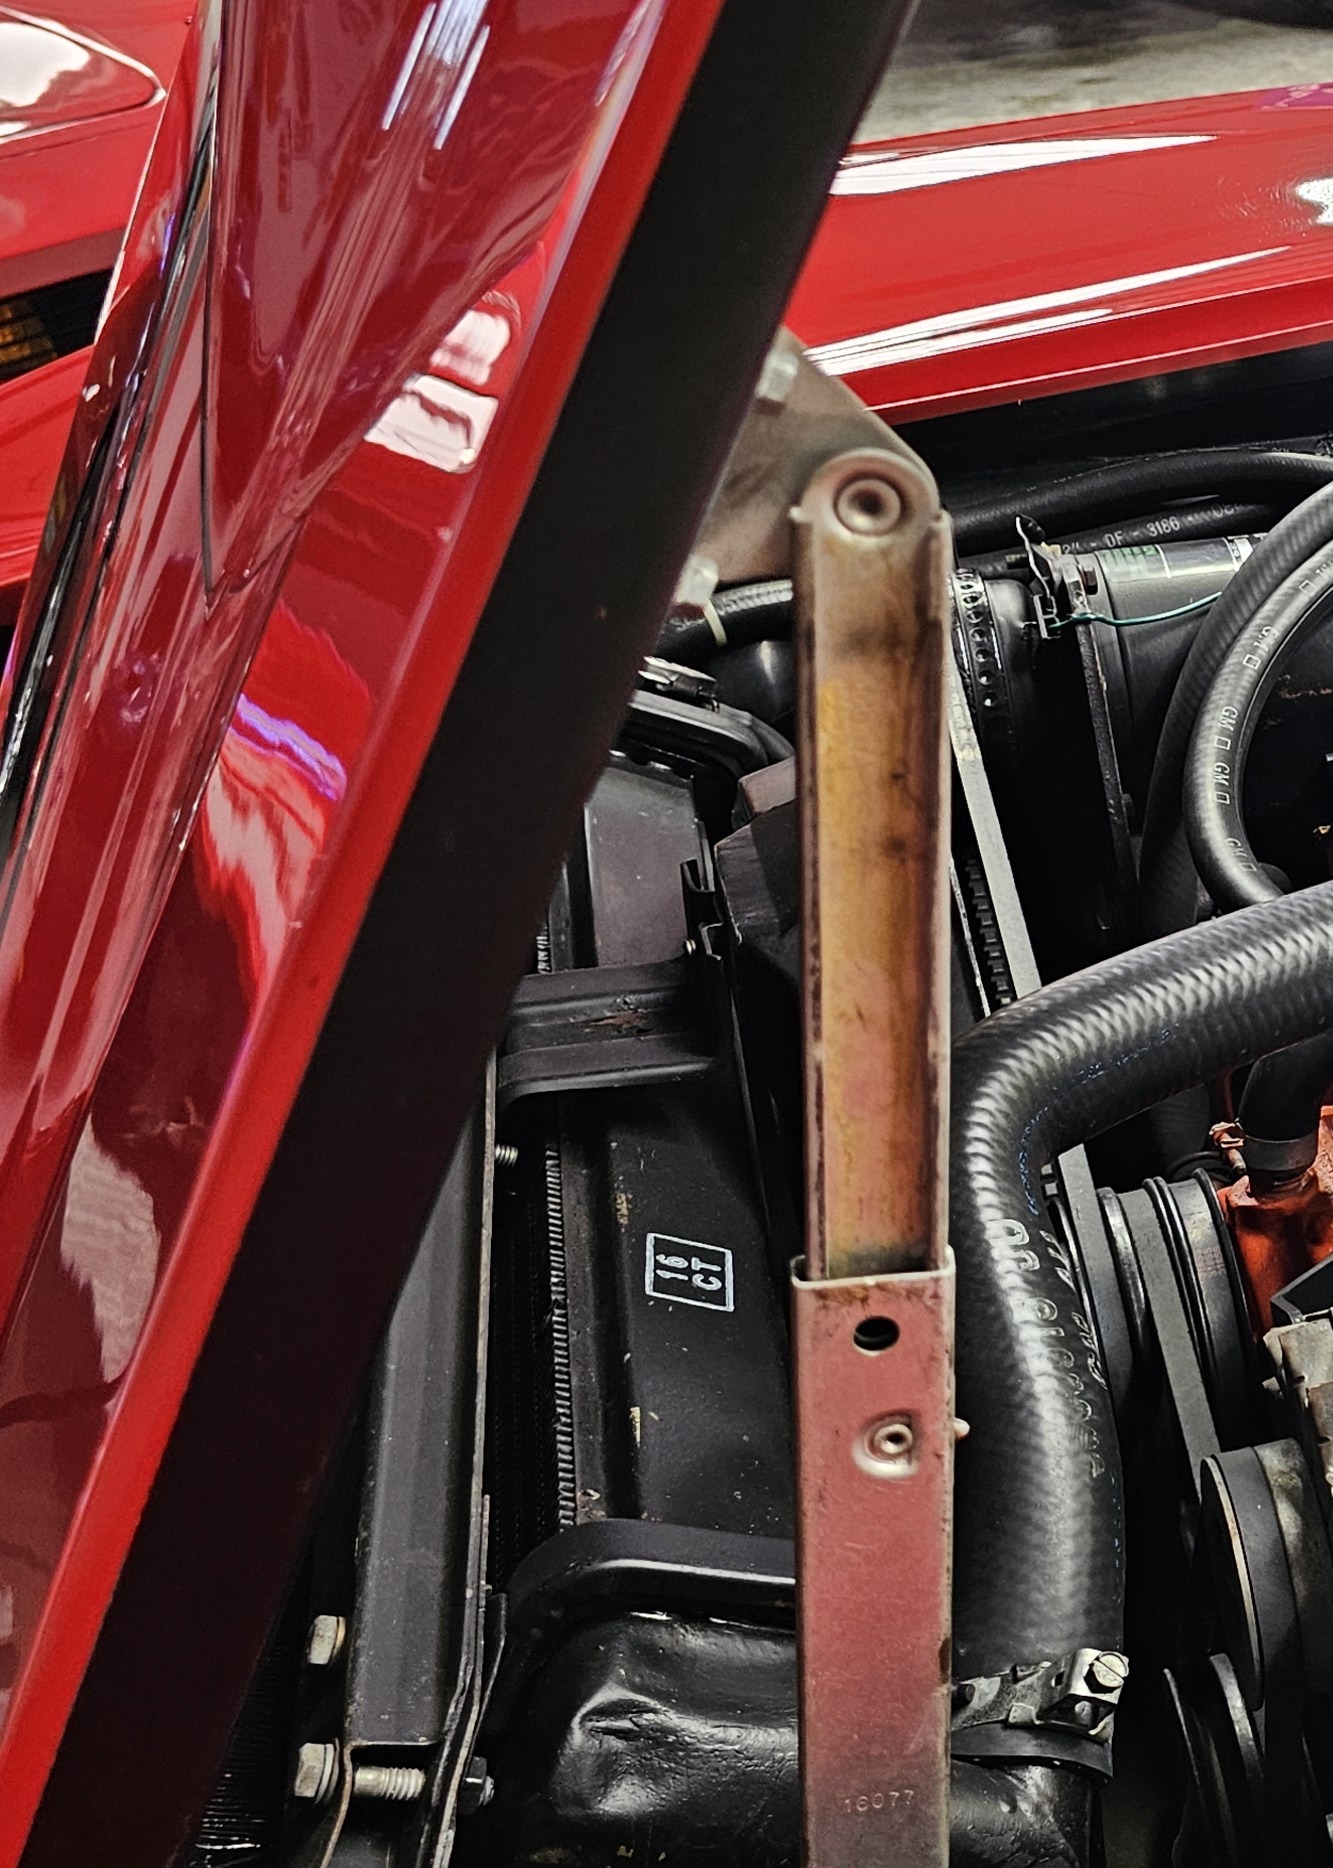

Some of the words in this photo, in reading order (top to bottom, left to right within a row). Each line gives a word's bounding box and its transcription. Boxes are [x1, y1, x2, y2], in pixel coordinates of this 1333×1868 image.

[1146, 516, 1180, 537] 3186
[1217, 705, 1239, 732] GM
[1213, 761, 1231, 787] GM
[655, 1253, 689, 1281] 16
[691, 1256, 723, 1291] CT
[845, 1789, 915, 1813] 16077
